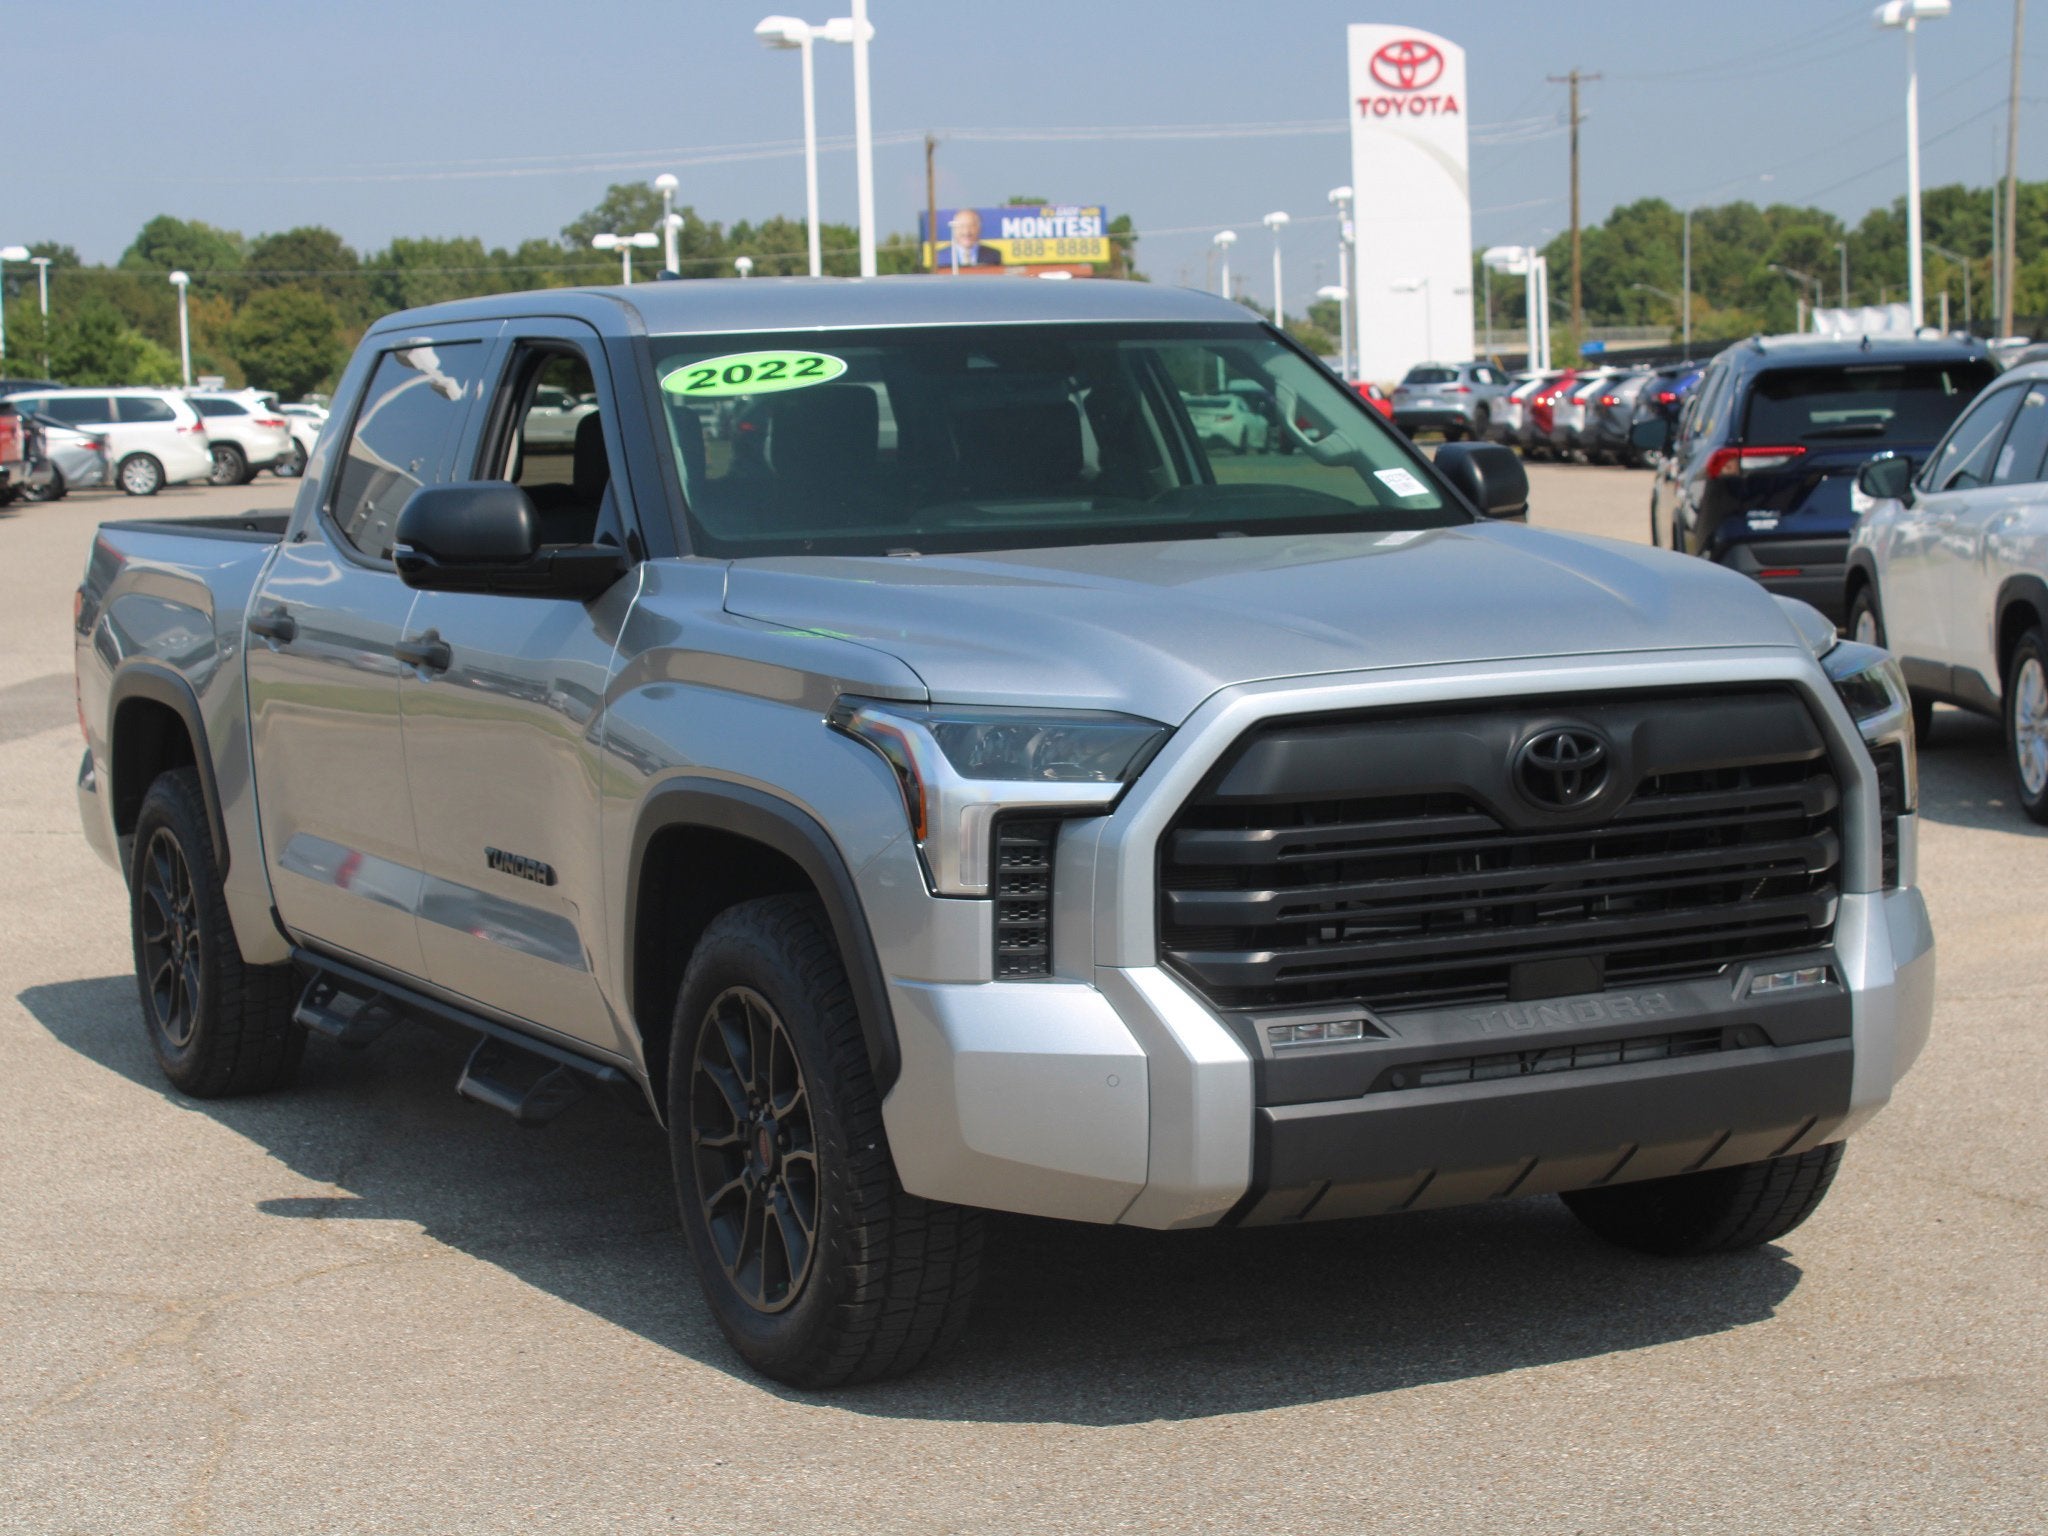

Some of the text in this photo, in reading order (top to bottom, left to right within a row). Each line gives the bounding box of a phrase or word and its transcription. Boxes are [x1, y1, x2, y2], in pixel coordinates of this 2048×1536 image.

[1357, 96, 1459, 118] TOYOTA
[1001, 216, 1101, 238] MONTESI
[686, 357, 825, 391] 2022
[485, 846, 557, 887] TUNDRA
[1467, 992, 1676, 1034] TUNDRA
